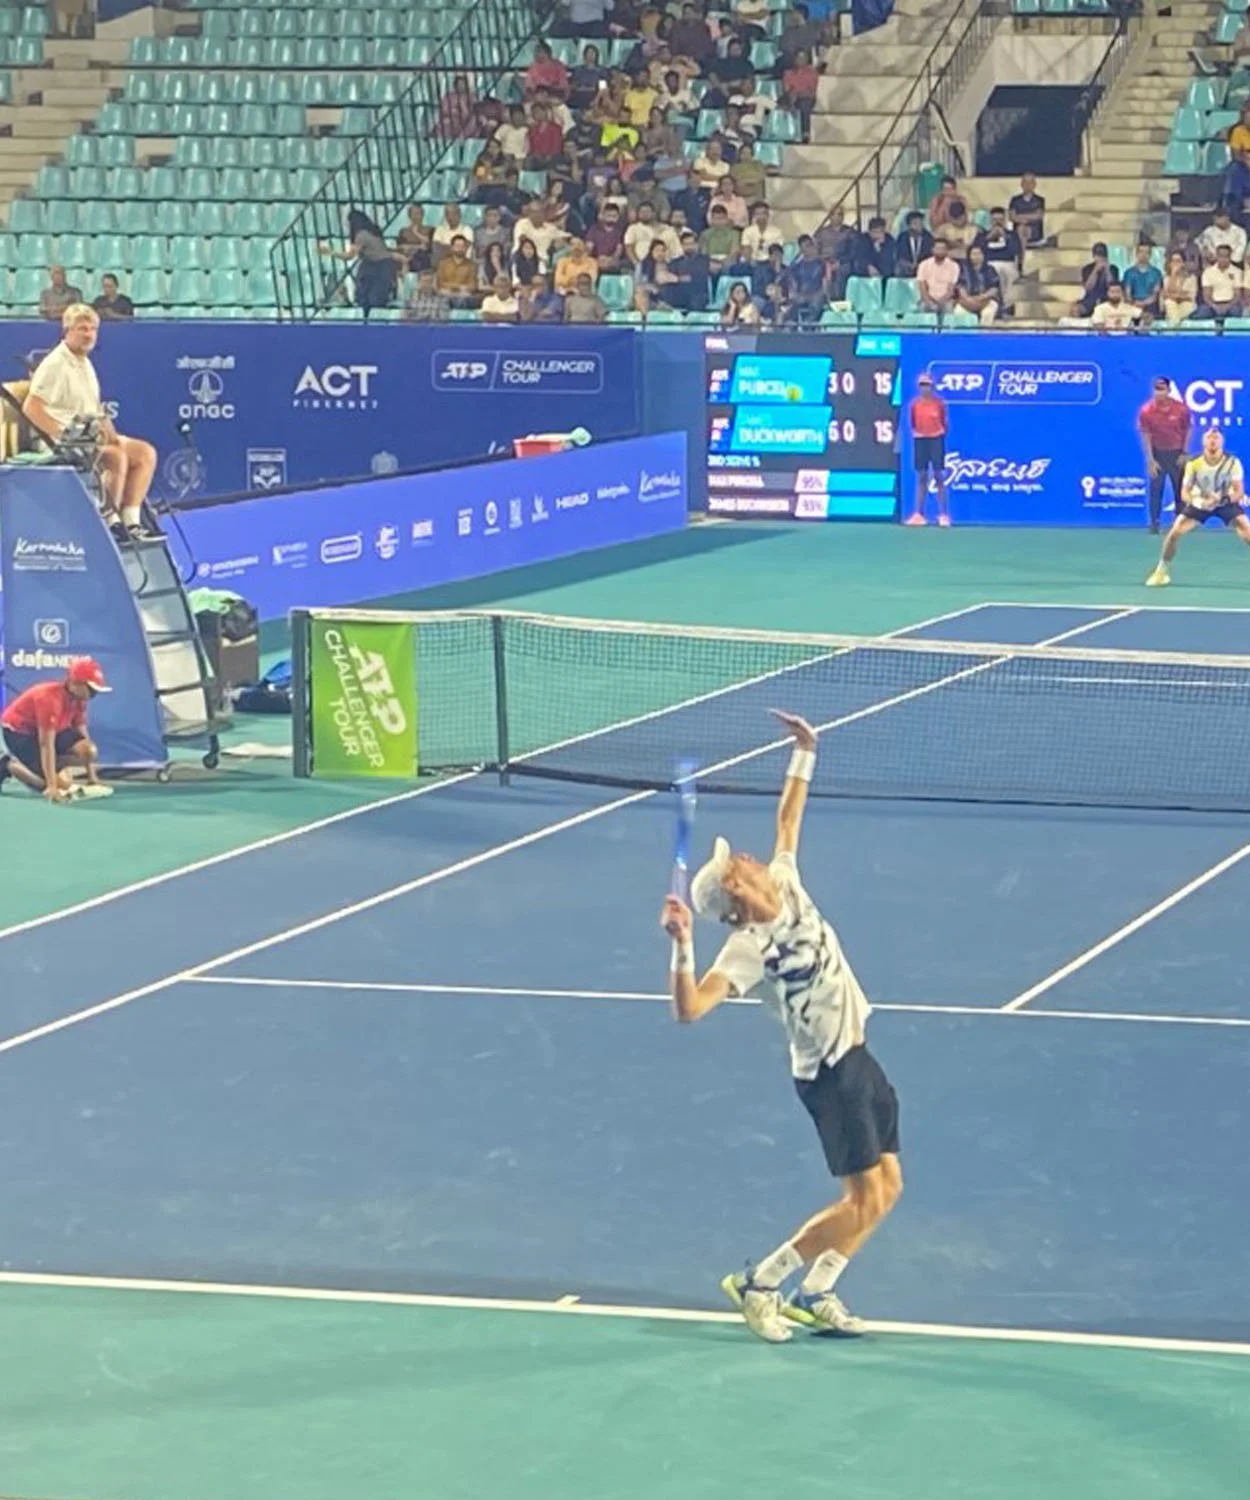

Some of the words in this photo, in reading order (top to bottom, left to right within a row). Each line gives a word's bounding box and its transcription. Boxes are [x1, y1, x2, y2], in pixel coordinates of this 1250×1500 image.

[441, 362, 488, 380] ATP
[503, 360, 595, 374] CHALLENGER
[998, 370, 1093, 384] CHALLENGER
[294, 366, 378, 397] ACT
[503, 372, 541, 384] TOUR
[843, 373, 855, 394] 0
[873, 373, 892, 395] 15
[936, 373, 985, 391] ATP
[998, 383, 1038, 396] TOUR
[1166, 380, 1243, 413] CT
[843, 421, 855, 442] 0
[873, 420, 893, 443] 15
[12, 648, 92, 669] dafaNE
[324, 629, 385, 768] CHALLENGER
[348, 641, 407, 735] ATP
[329, 696, 361, 757] TOUR
